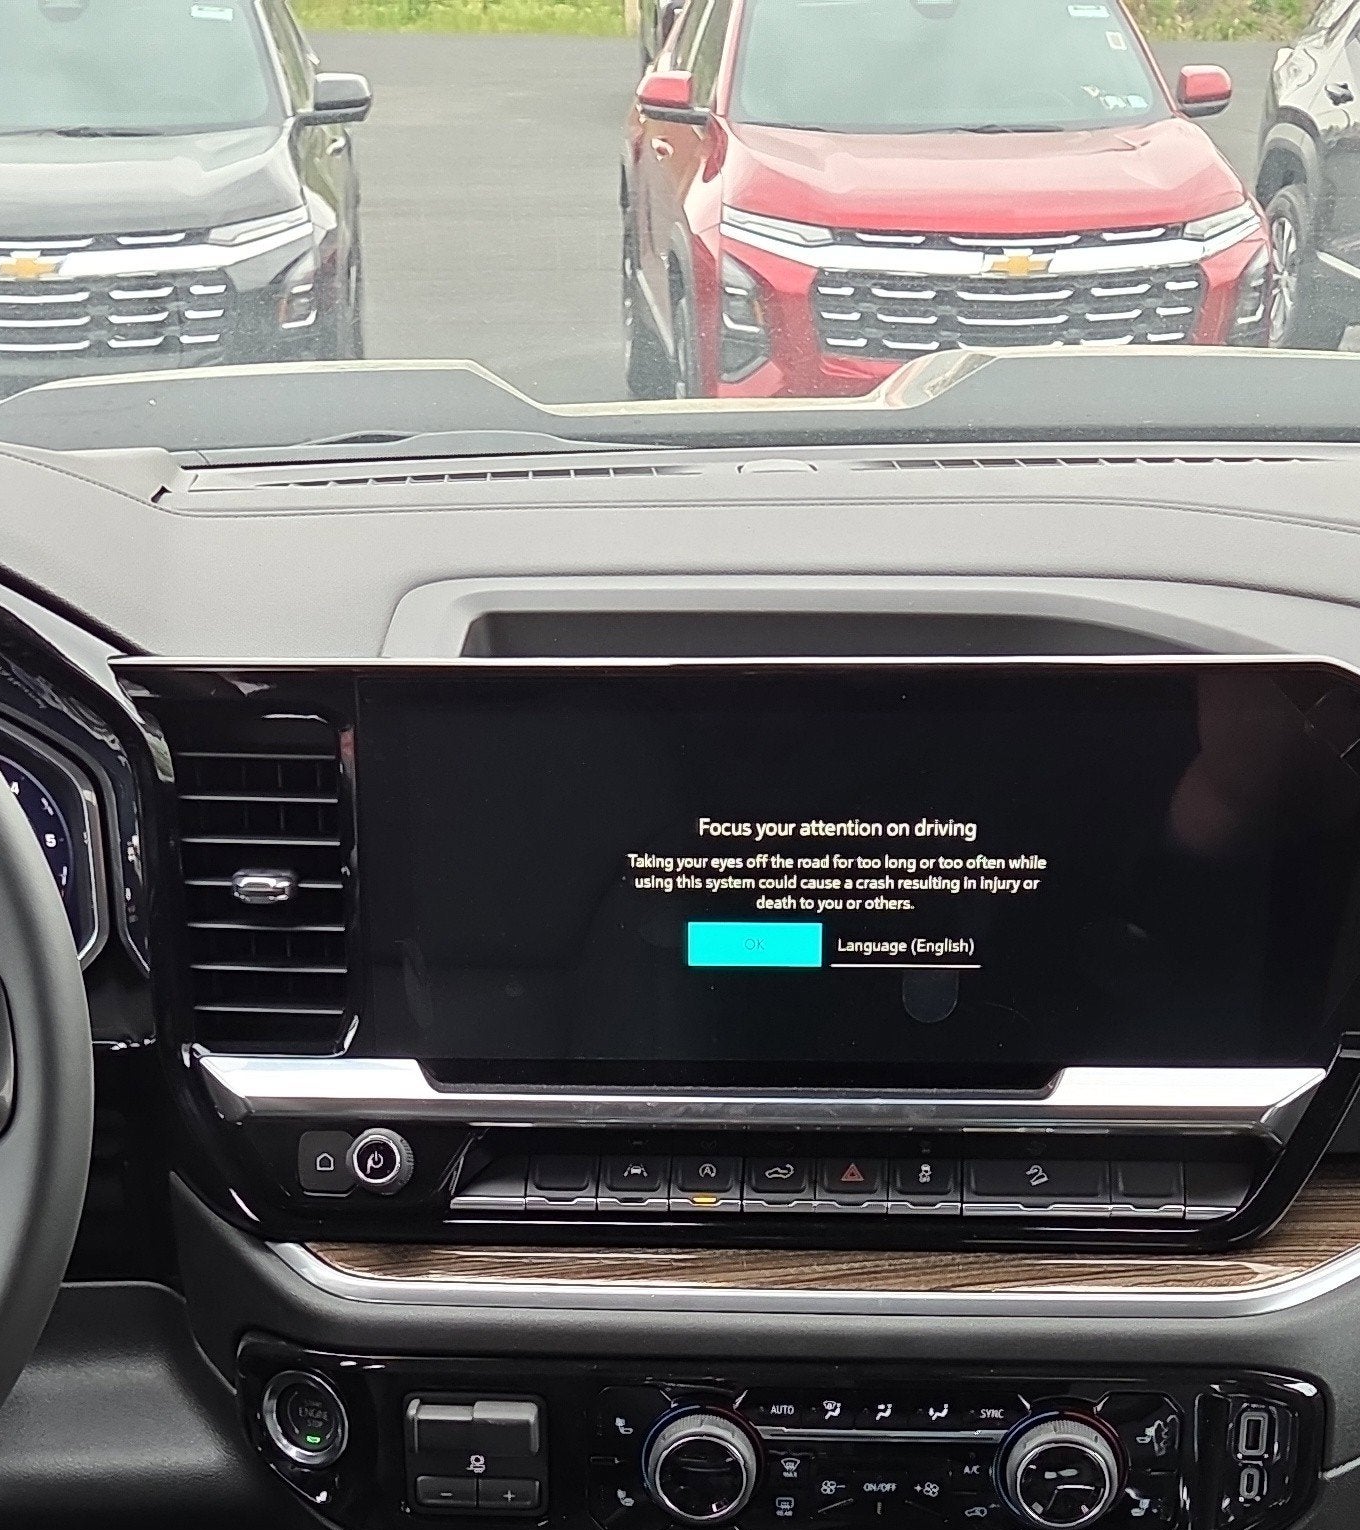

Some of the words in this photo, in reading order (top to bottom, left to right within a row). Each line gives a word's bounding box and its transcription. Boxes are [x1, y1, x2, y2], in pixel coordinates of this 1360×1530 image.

[698, 817, 753, 837] Focus
[755, 822, 796, 842] your
[799, 819, 883, 837] attention
[886, 822, 910, 837] on
[914, 817, 978, 842] driving
[44, 833, 57, 848] 5
[627, 853, 674, 873] Taking
[676, 857, 708, 873] your
[710, 857, 744, 873] eyes
[746, 853, 769, 869] off
[770, 853, 794, 869] the
[797, 854, 830, 869] road
[832, 853, 854, 869] for
[856, 855, 882, 869] too
[884, 854, 917, 873] long
[919, 857, 937, 870] or
[939, 855, 964, 870] too
[966, 854, 1006, 870] often
[1008, 854, 1048, 870] while
[634, 875, 673, 892] using
[676, 874, 703, 889] this
[705, 875, 756, 892] system
[758, 874, 798, 889] could
[800, 877, 841, 889] cause
[843, 878, 855, 890] a
[855, 875, 895, 890] crash
[897, 875, 961, 893] resulting
[963, 876, 977, 890] in
[980, 876, 1022, 893] injury
[1022, 879, 1041, 890] or
[755, 895, 797, 910] death
[799, 896, 814, 910] to
[816, 898, 843, 914] you
[845, 898, 863, 910] or
[864, 895, 915, 910] others.
[744, 938, 765, 951] OK
[837, 938, 907, 956] Language
[910, 938, 975, 957] (English)
[770, 1404, 795, 1415] AUTO
[979, 1408, 1005, 1419] SYNC
[963, 1465, 981, 1475] A/C
[863, 1482, 897, 1493] ON/OFF
